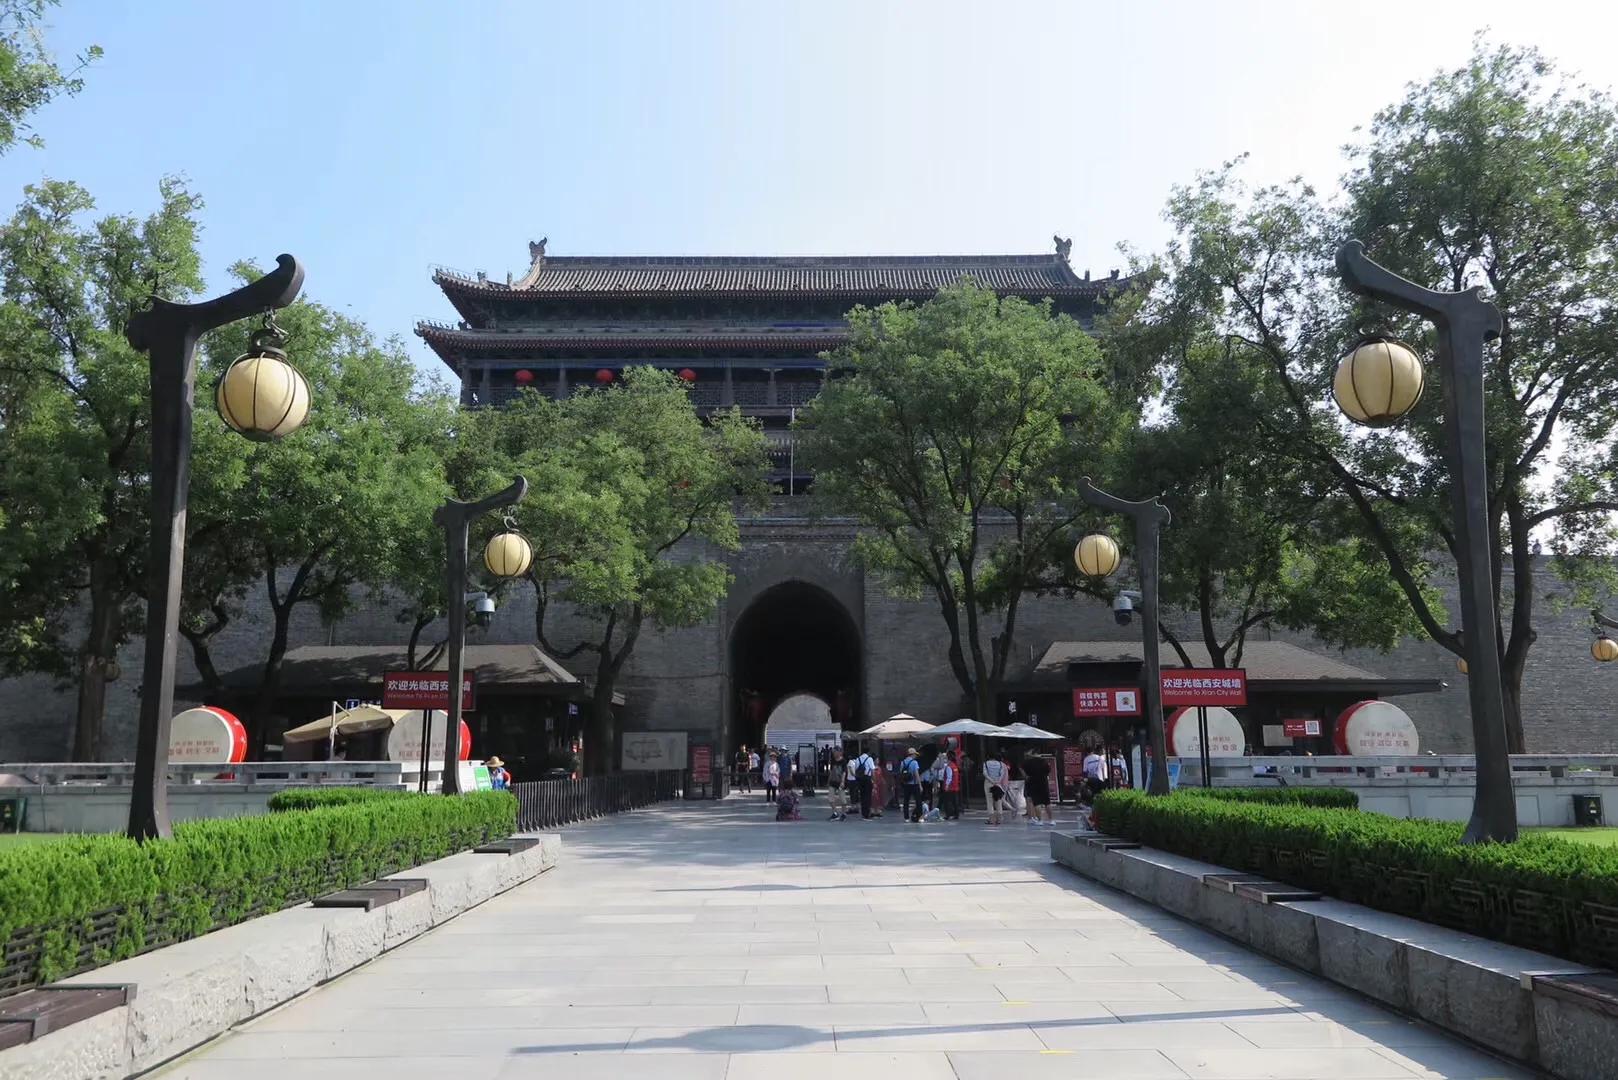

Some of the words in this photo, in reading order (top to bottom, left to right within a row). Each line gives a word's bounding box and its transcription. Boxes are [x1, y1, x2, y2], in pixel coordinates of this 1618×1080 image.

[388, 680, 471, 691] 欢迎光临西安墙
[1163, 678, 1241, 688] 欢迎光临西安城墙
[1217, 689, 1228, 697] City
